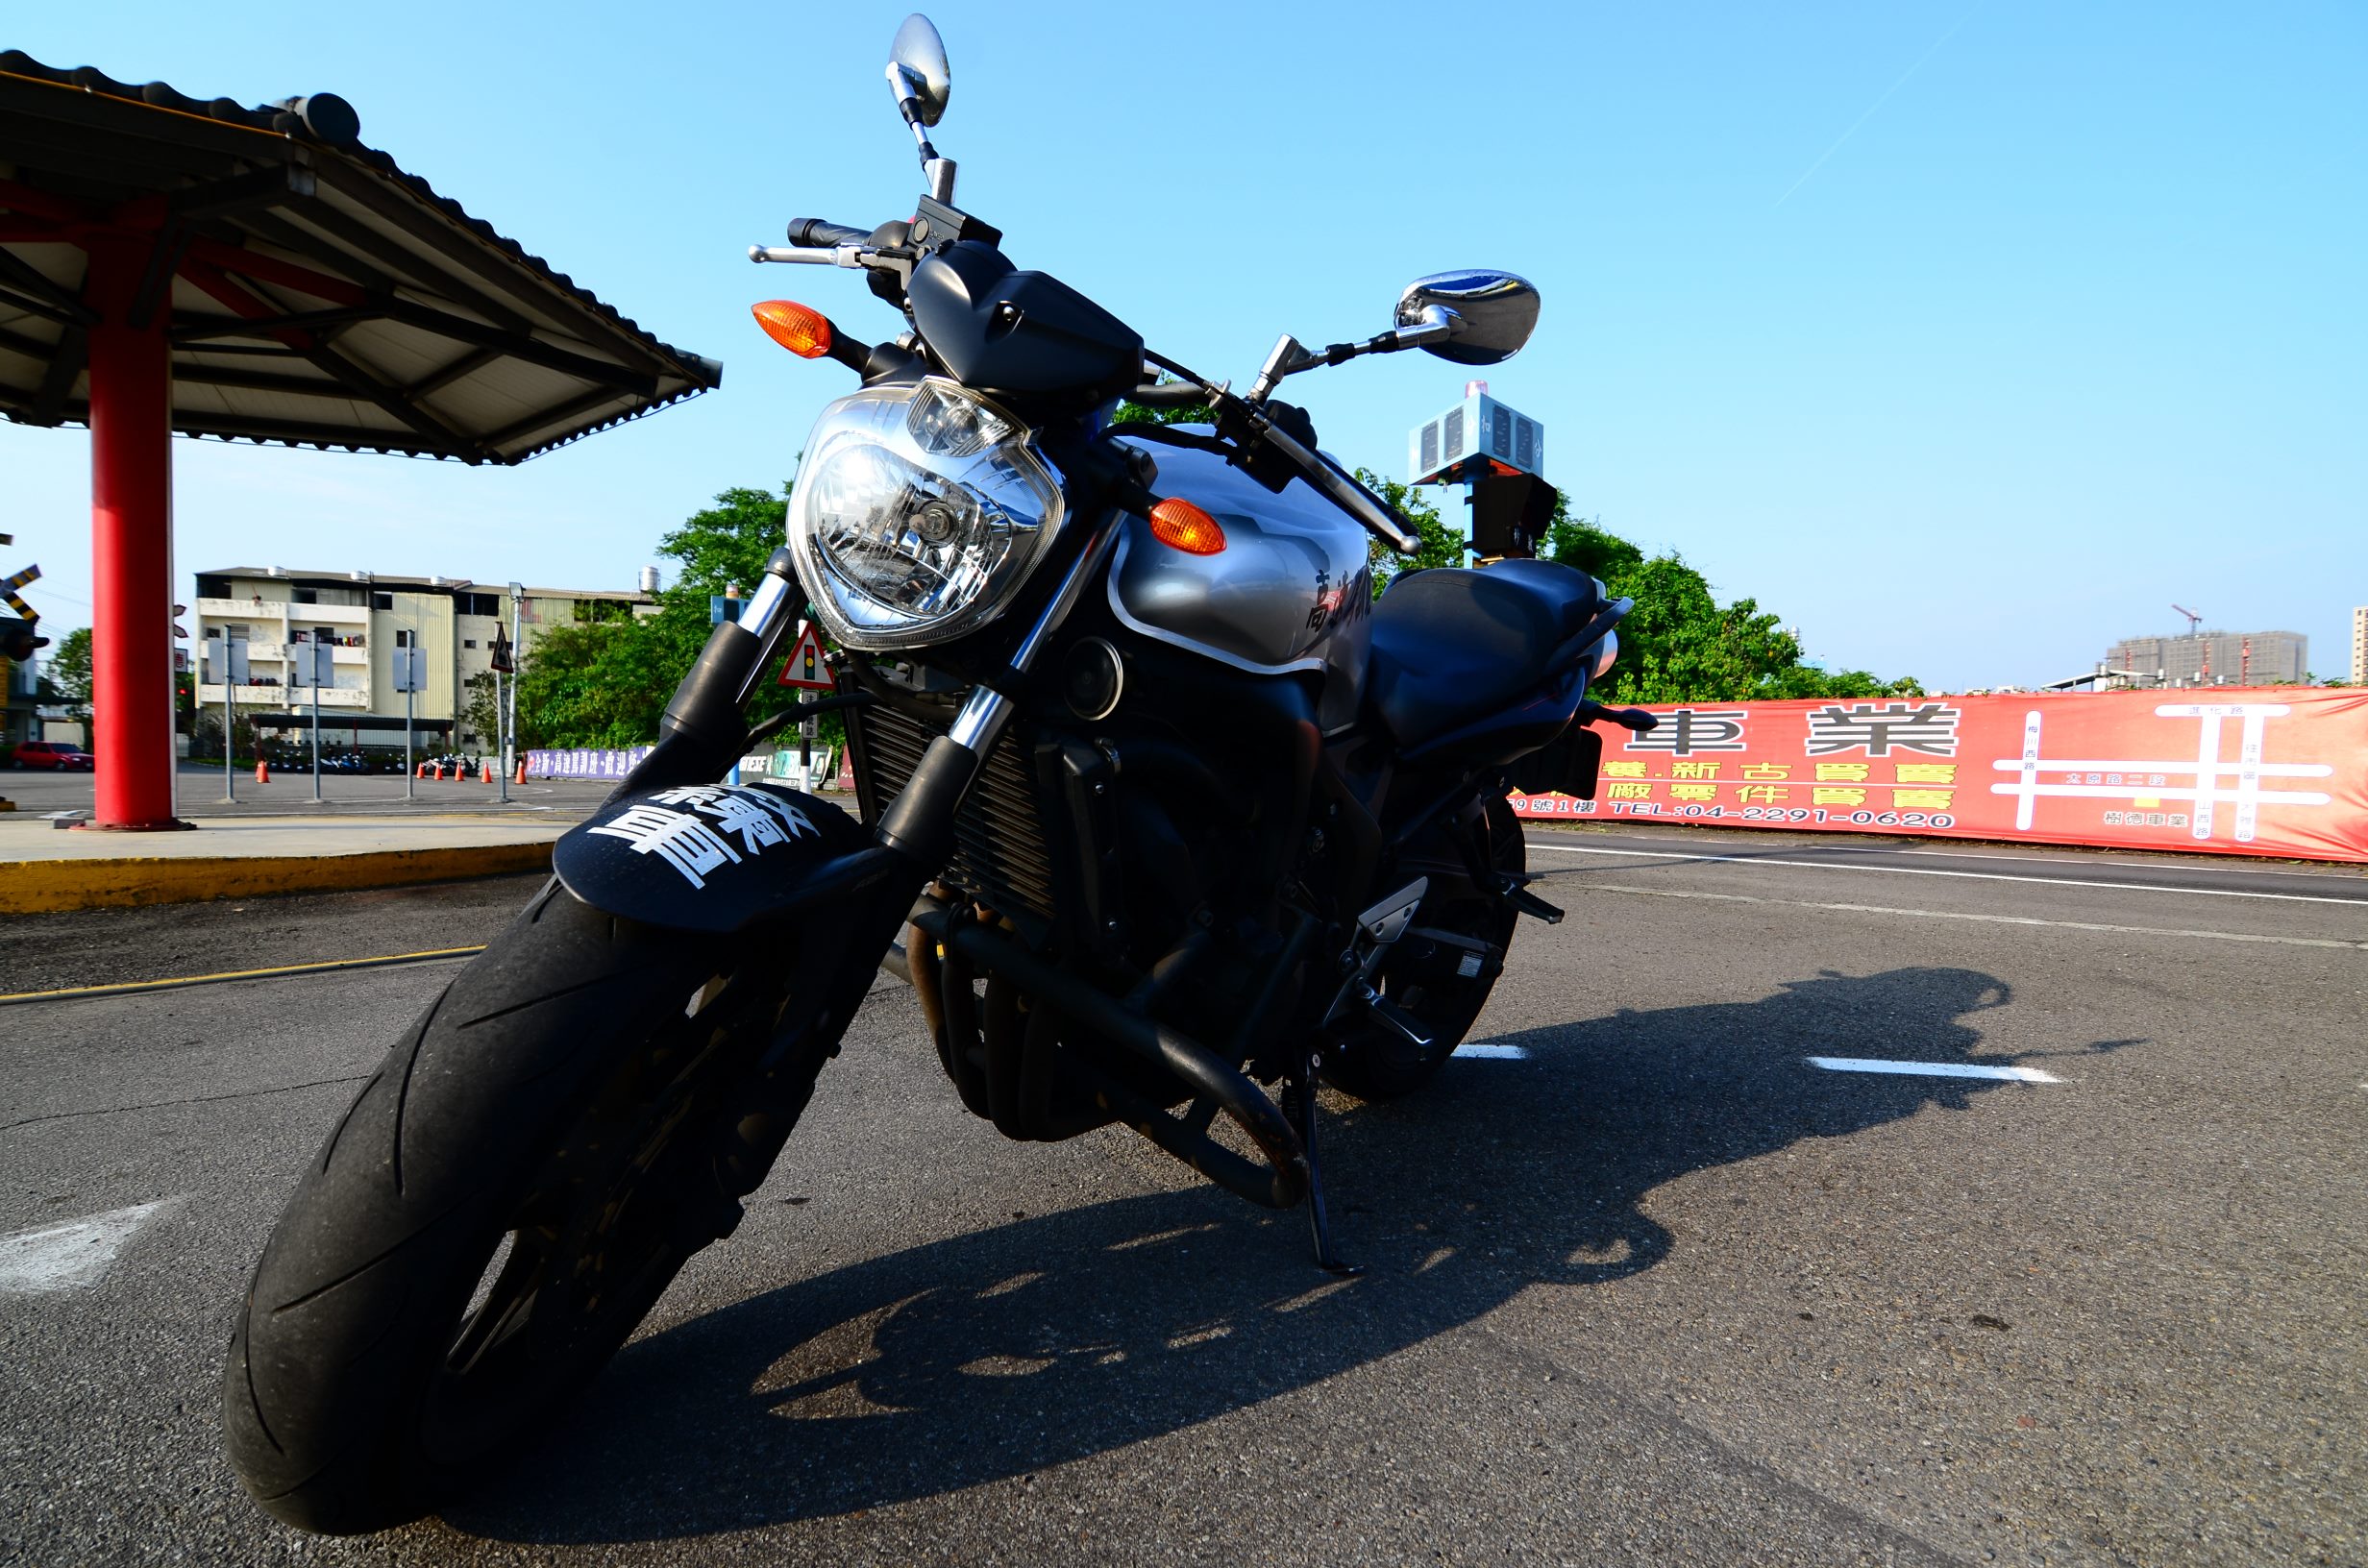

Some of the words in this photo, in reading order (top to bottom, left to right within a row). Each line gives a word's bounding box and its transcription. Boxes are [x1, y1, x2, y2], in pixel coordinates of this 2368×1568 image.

[1623, 702, 1961, 757] 車業
[2024, 725, 2038, 771] 梅川西路
[2066, 773, 2165, 786] 太原路二段
[1509, 782, 1956, 811] 廠零件買賣
[1609, 800, 1957, 829] TEL:04-2291-0620
[2105, 811, 2188, 827] 樹德車業
[2195, 800, 2210, 836] 山西路
